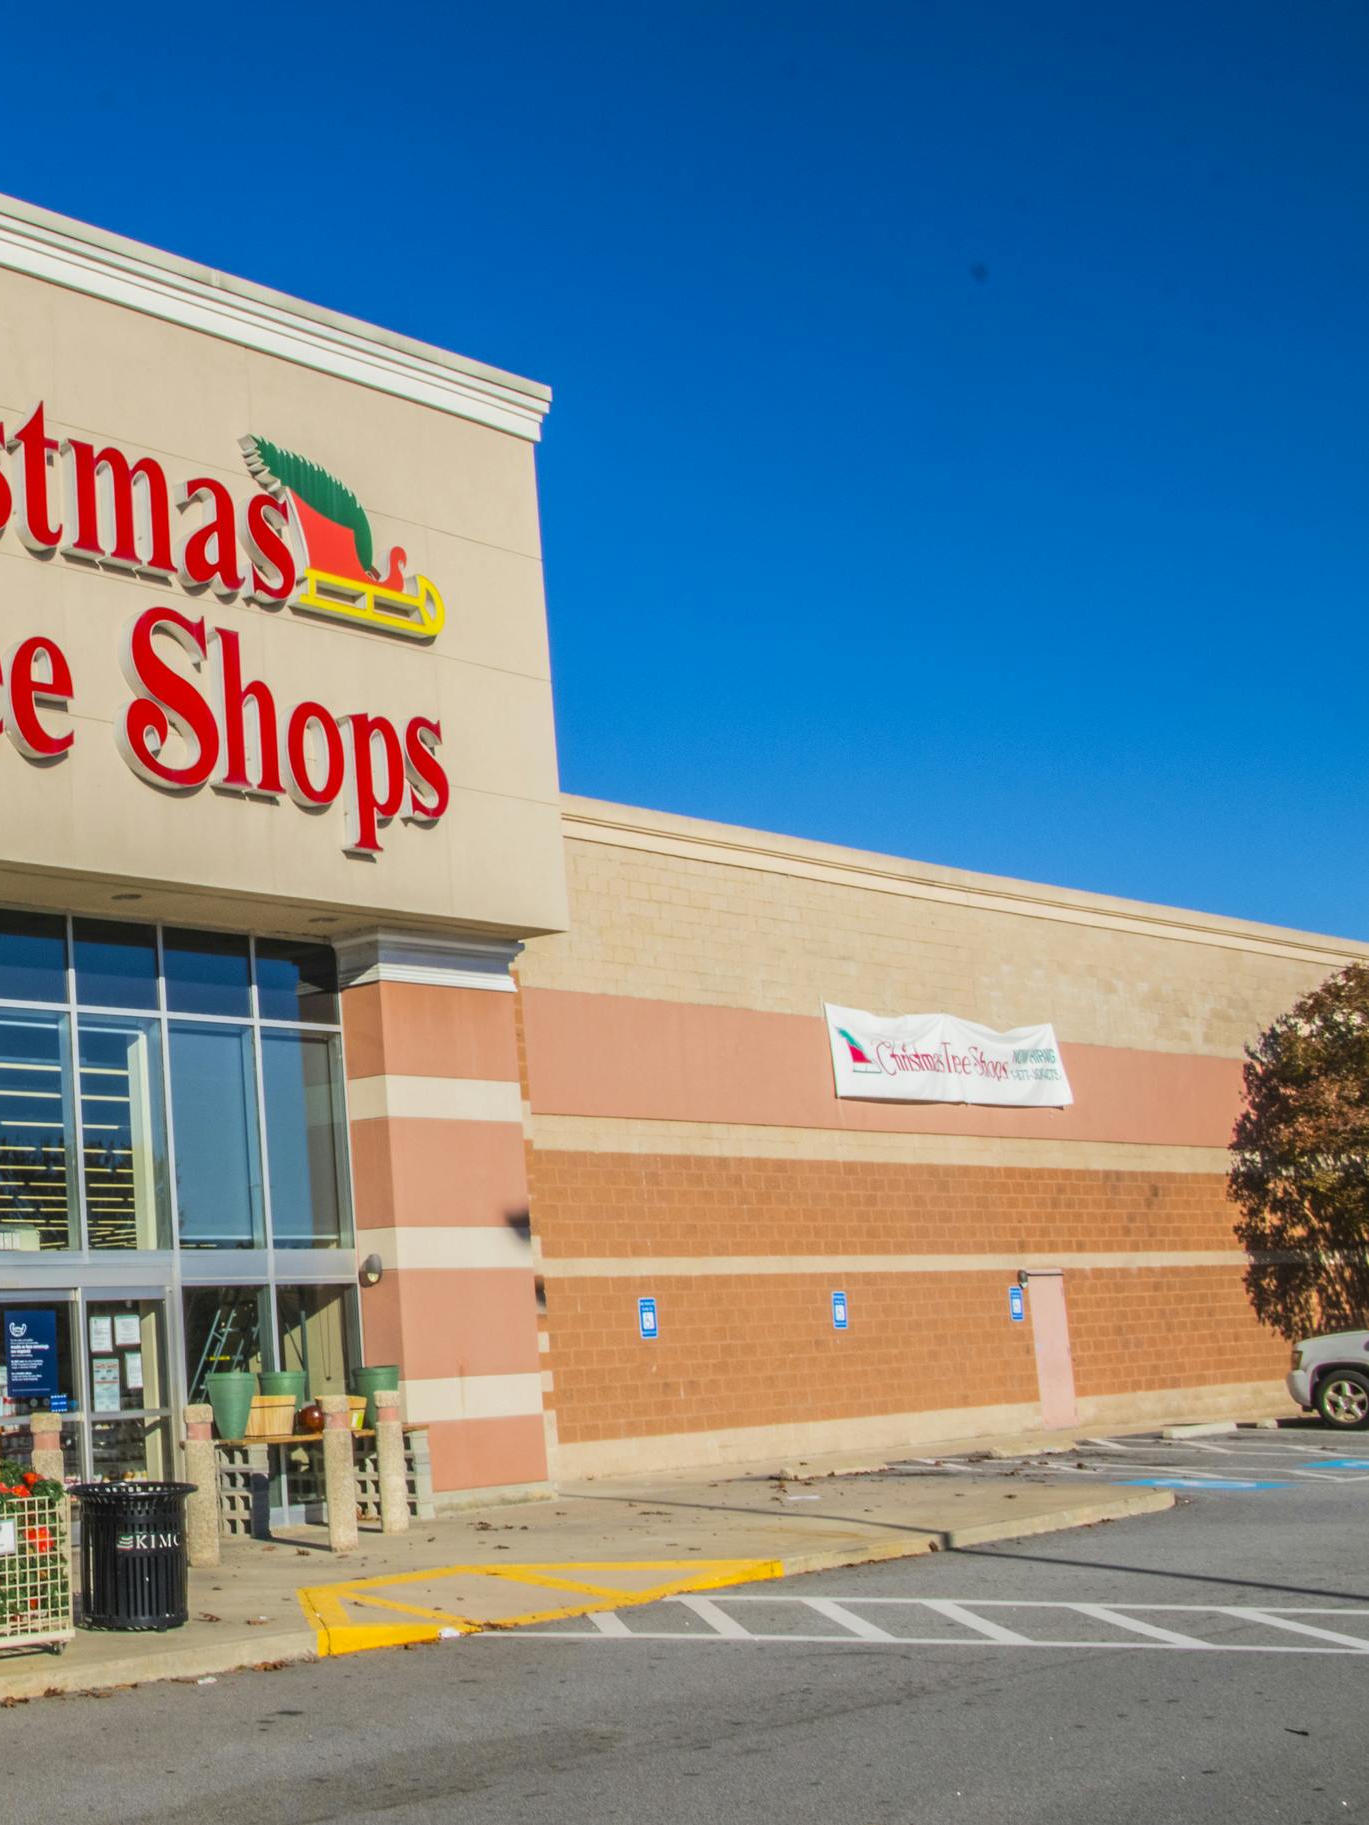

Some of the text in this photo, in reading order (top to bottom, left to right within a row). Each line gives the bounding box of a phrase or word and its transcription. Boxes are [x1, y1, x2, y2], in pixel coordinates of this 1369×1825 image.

[115, 606, 449, 858] Shops
[875, 1040, 1010, 1081] Christmas Tree Shops
